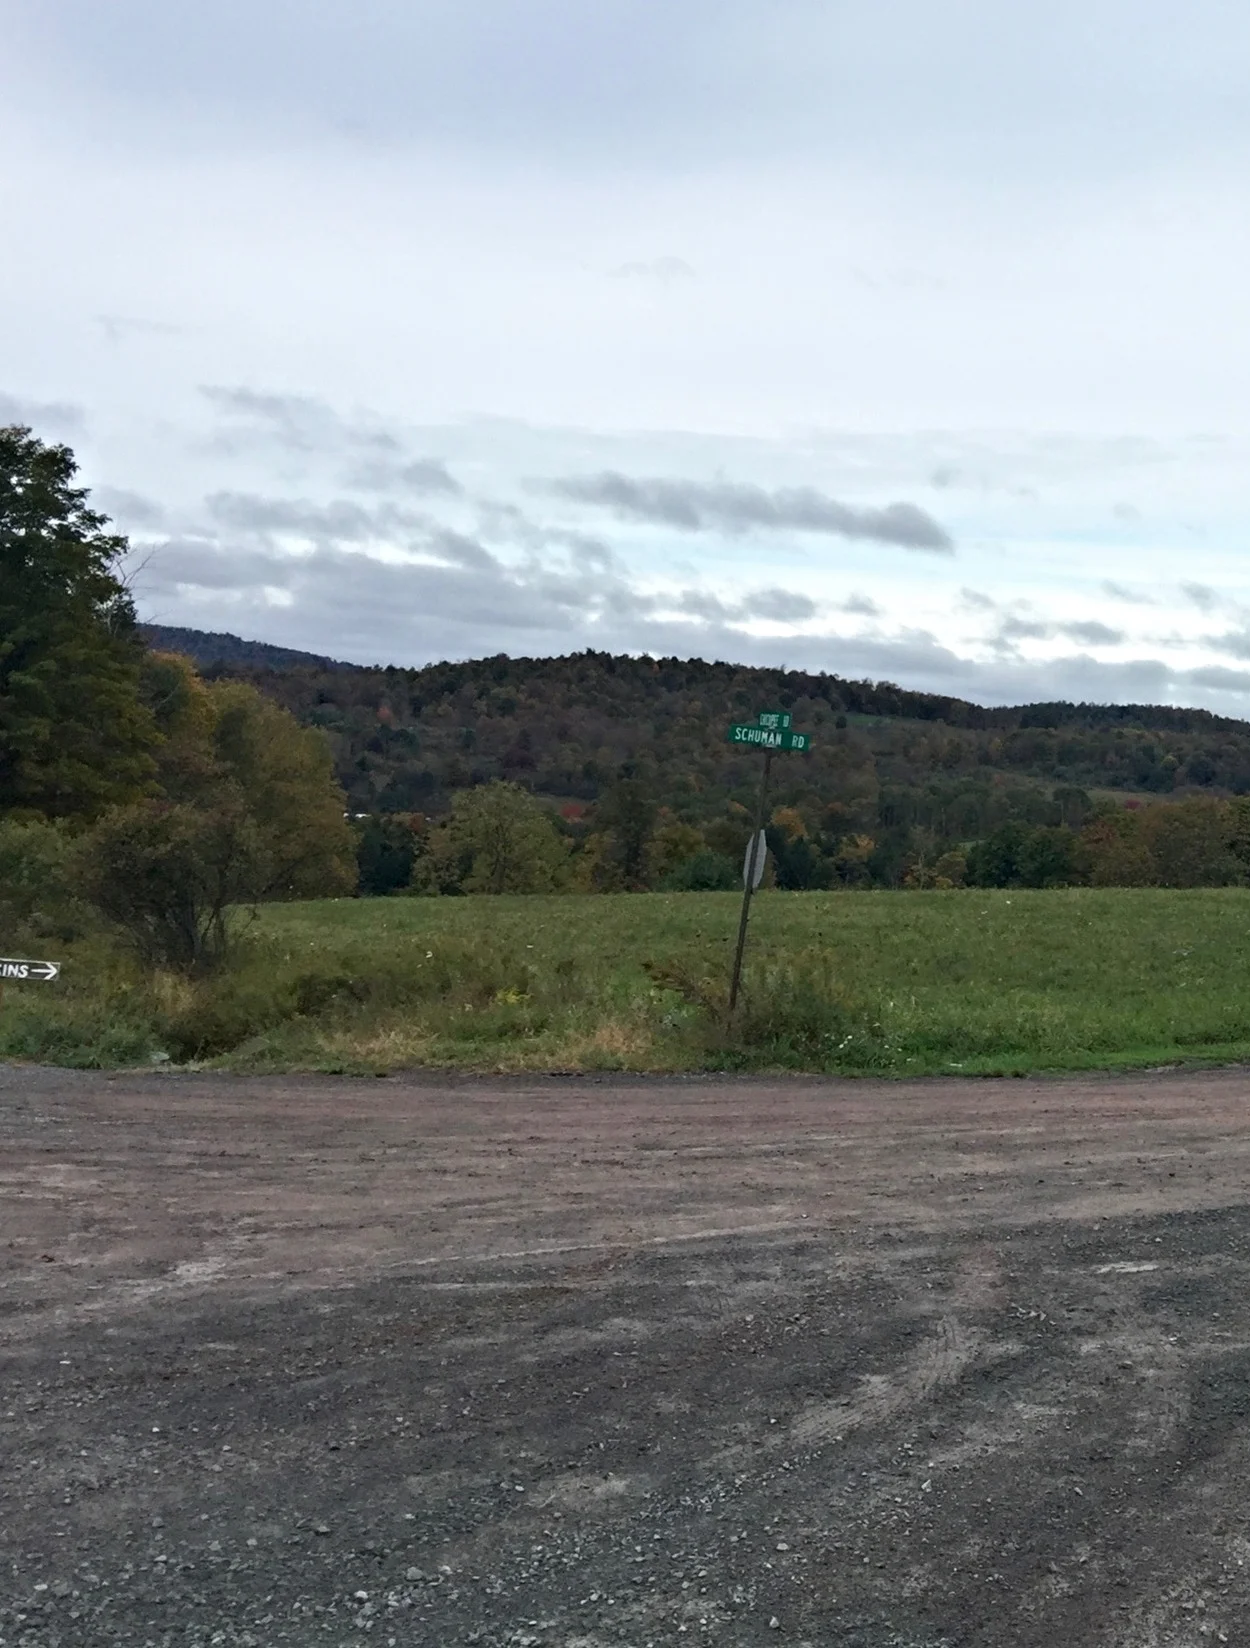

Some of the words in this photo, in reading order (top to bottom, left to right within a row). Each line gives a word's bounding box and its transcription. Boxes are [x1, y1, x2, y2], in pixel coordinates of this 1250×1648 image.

[735, 727, 782, 745] SCHUMAN
[791, 735, 805, 748] RD
[0, 963, 29, 978] INS
